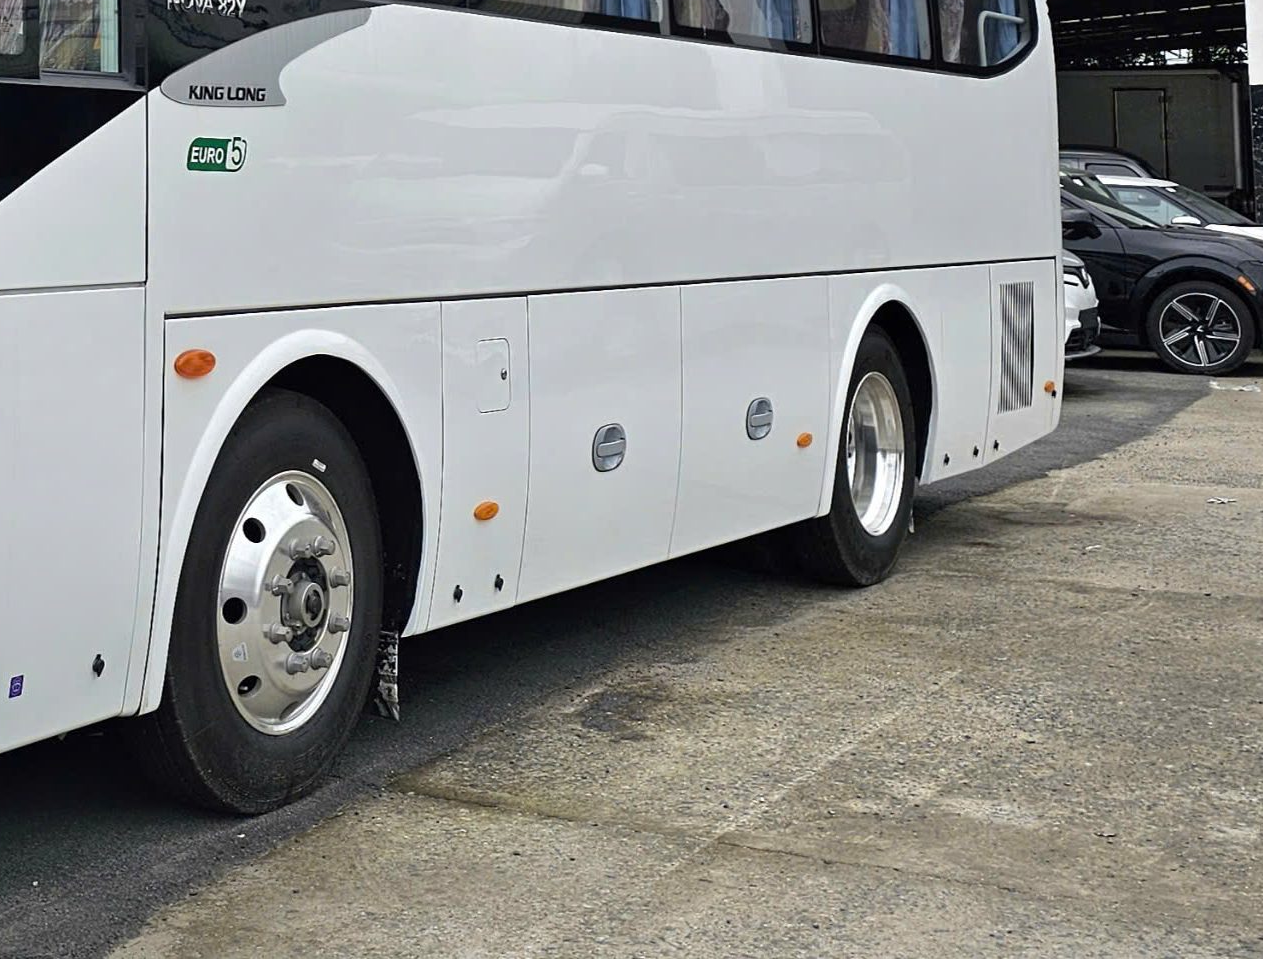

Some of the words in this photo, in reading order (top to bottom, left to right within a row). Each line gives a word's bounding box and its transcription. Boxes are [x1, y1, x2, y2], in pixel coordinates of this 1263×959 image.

[188, 85, 224, 100] KING
[227, 87, 266, 102] LONG
[190, 145, 225, 164] EURO
[231, 136, 243, 166] 5
